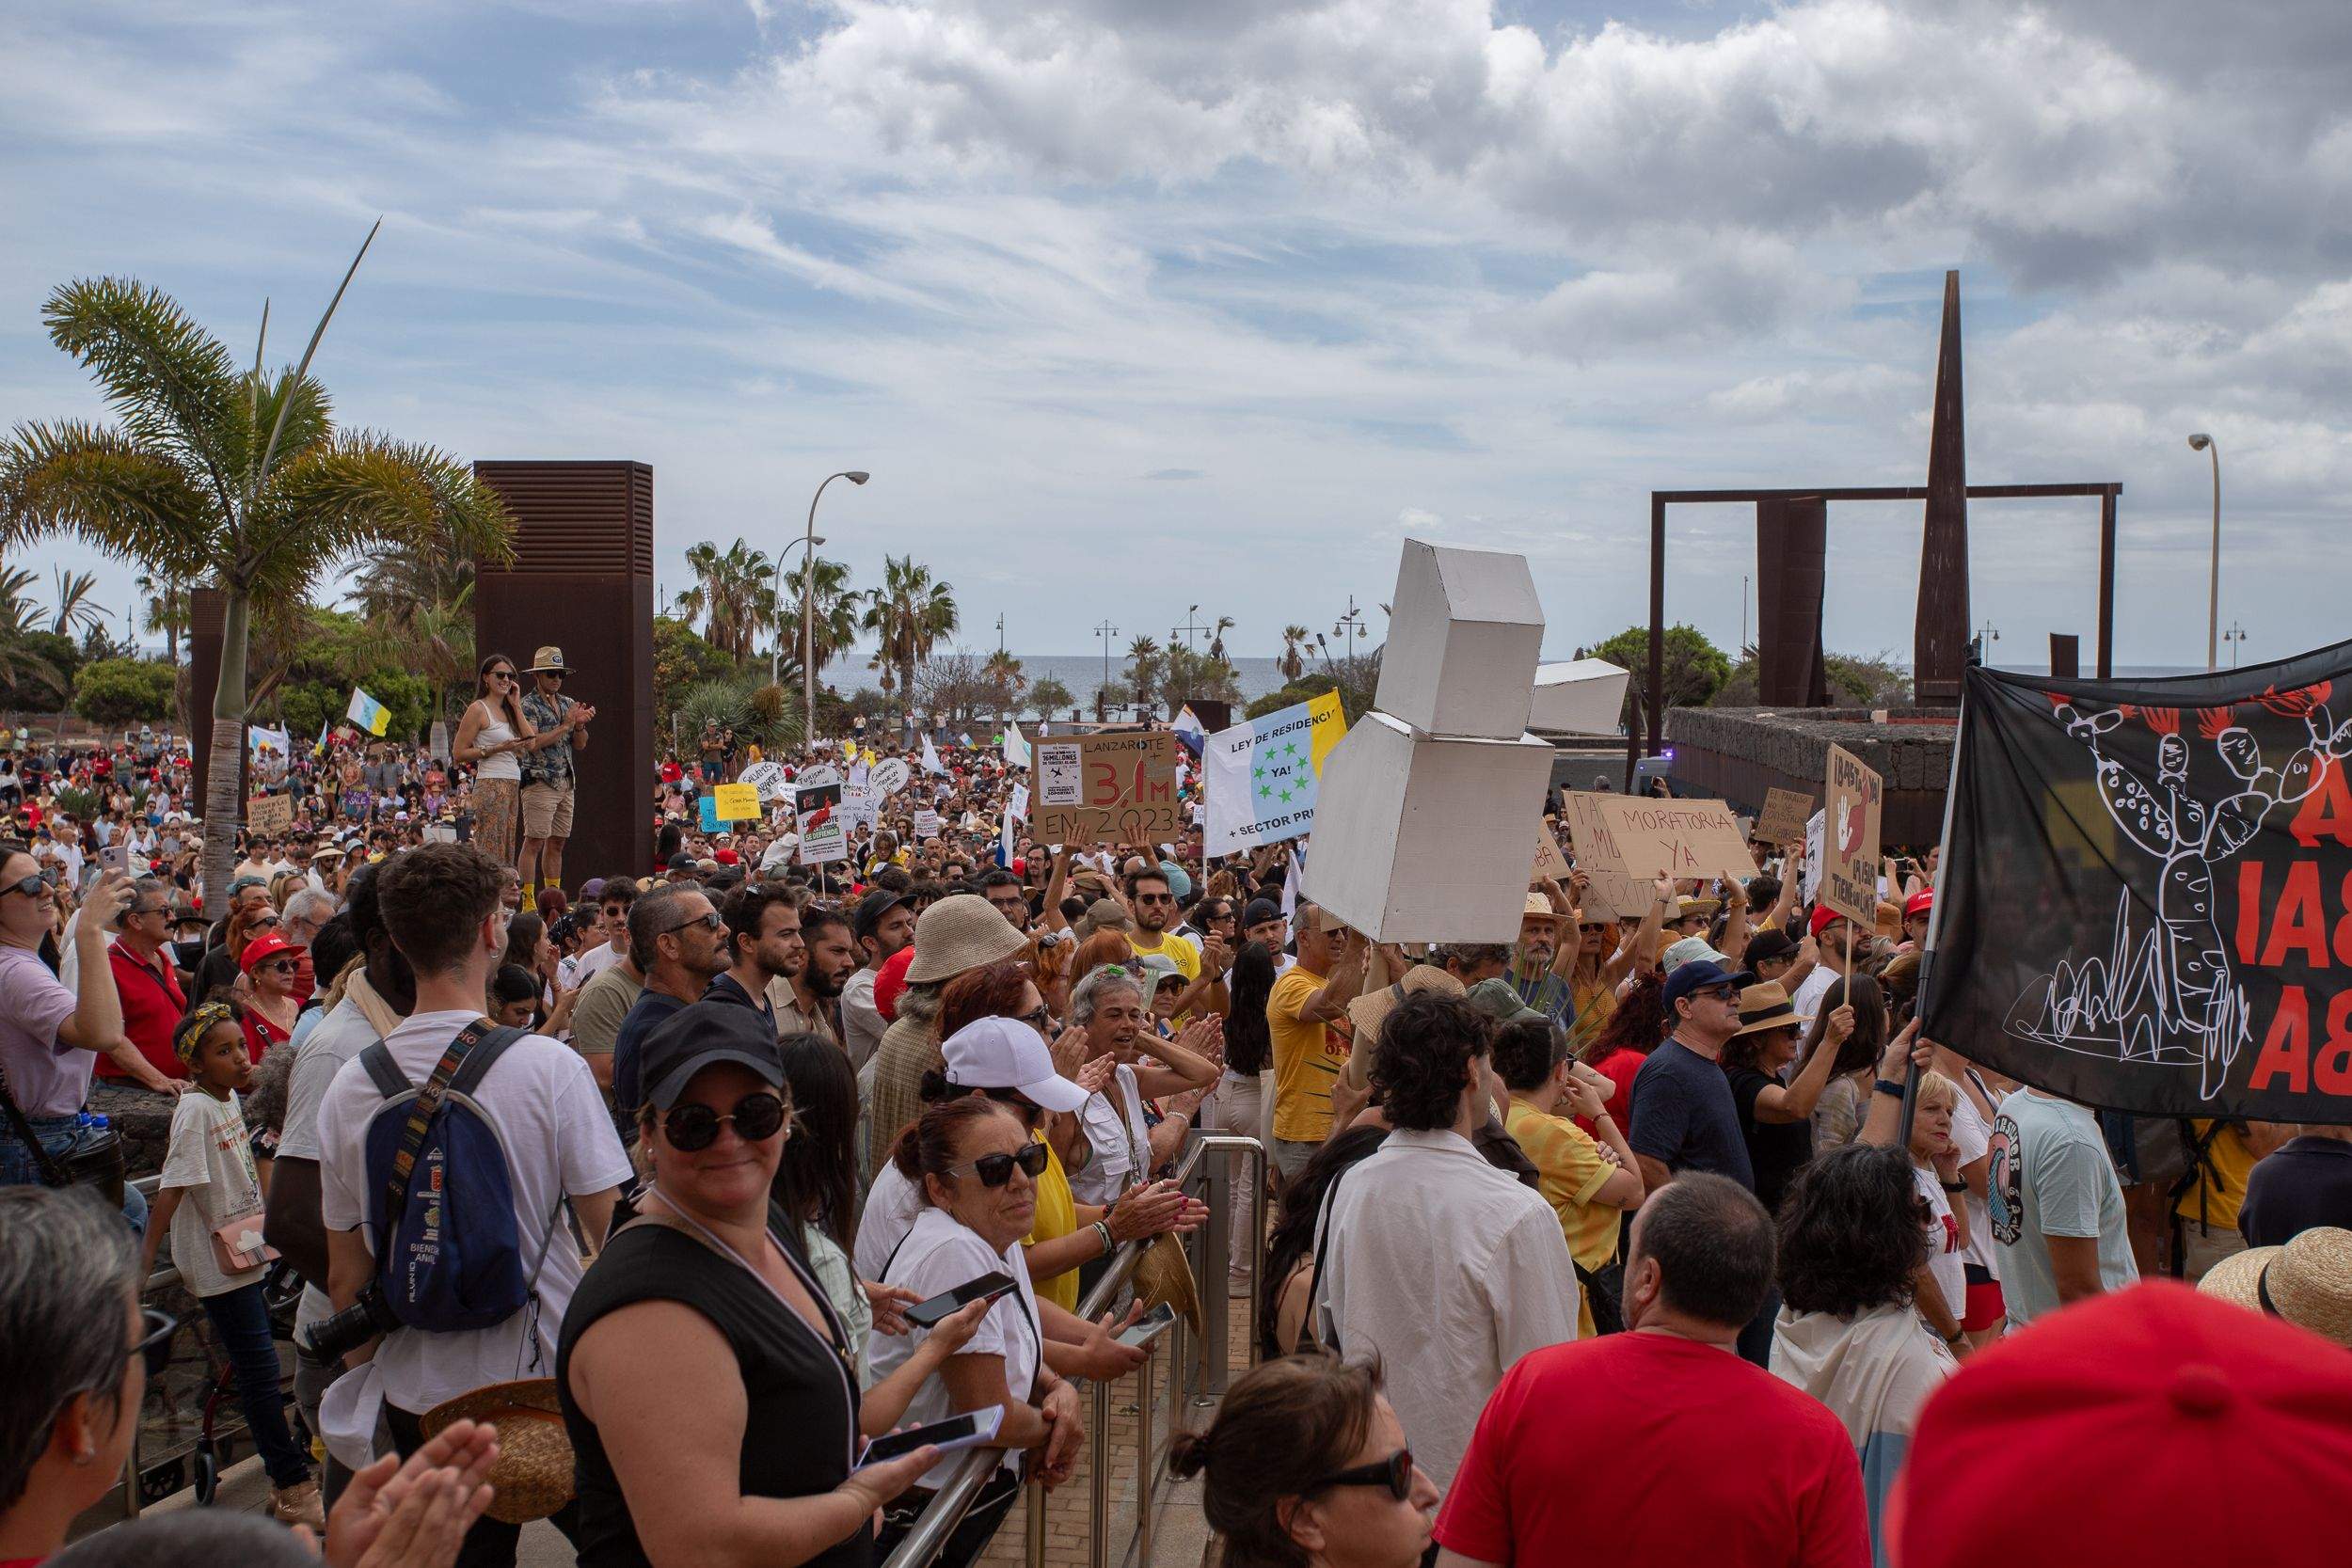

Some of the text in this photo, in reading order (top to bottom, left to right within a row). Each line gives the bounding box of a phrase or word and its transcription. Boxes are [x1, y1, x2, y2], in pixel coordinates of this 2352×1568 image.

[1084, 737, 1166, 753] LANZAROTE
[1231, 738, 1252, 753] LEY
[1255, 731, 1269, 744] DE
[1271, 766, 1292, 778] YA!
[1045, 812, 1077, 835] EN
[1096, 808, 1173, 834] 2023
[1239, 816, 1291, 835] SECTOR
[1623, 809, 1734, 832] MORATORIA
[1659, 838, 1700, 871] YA
